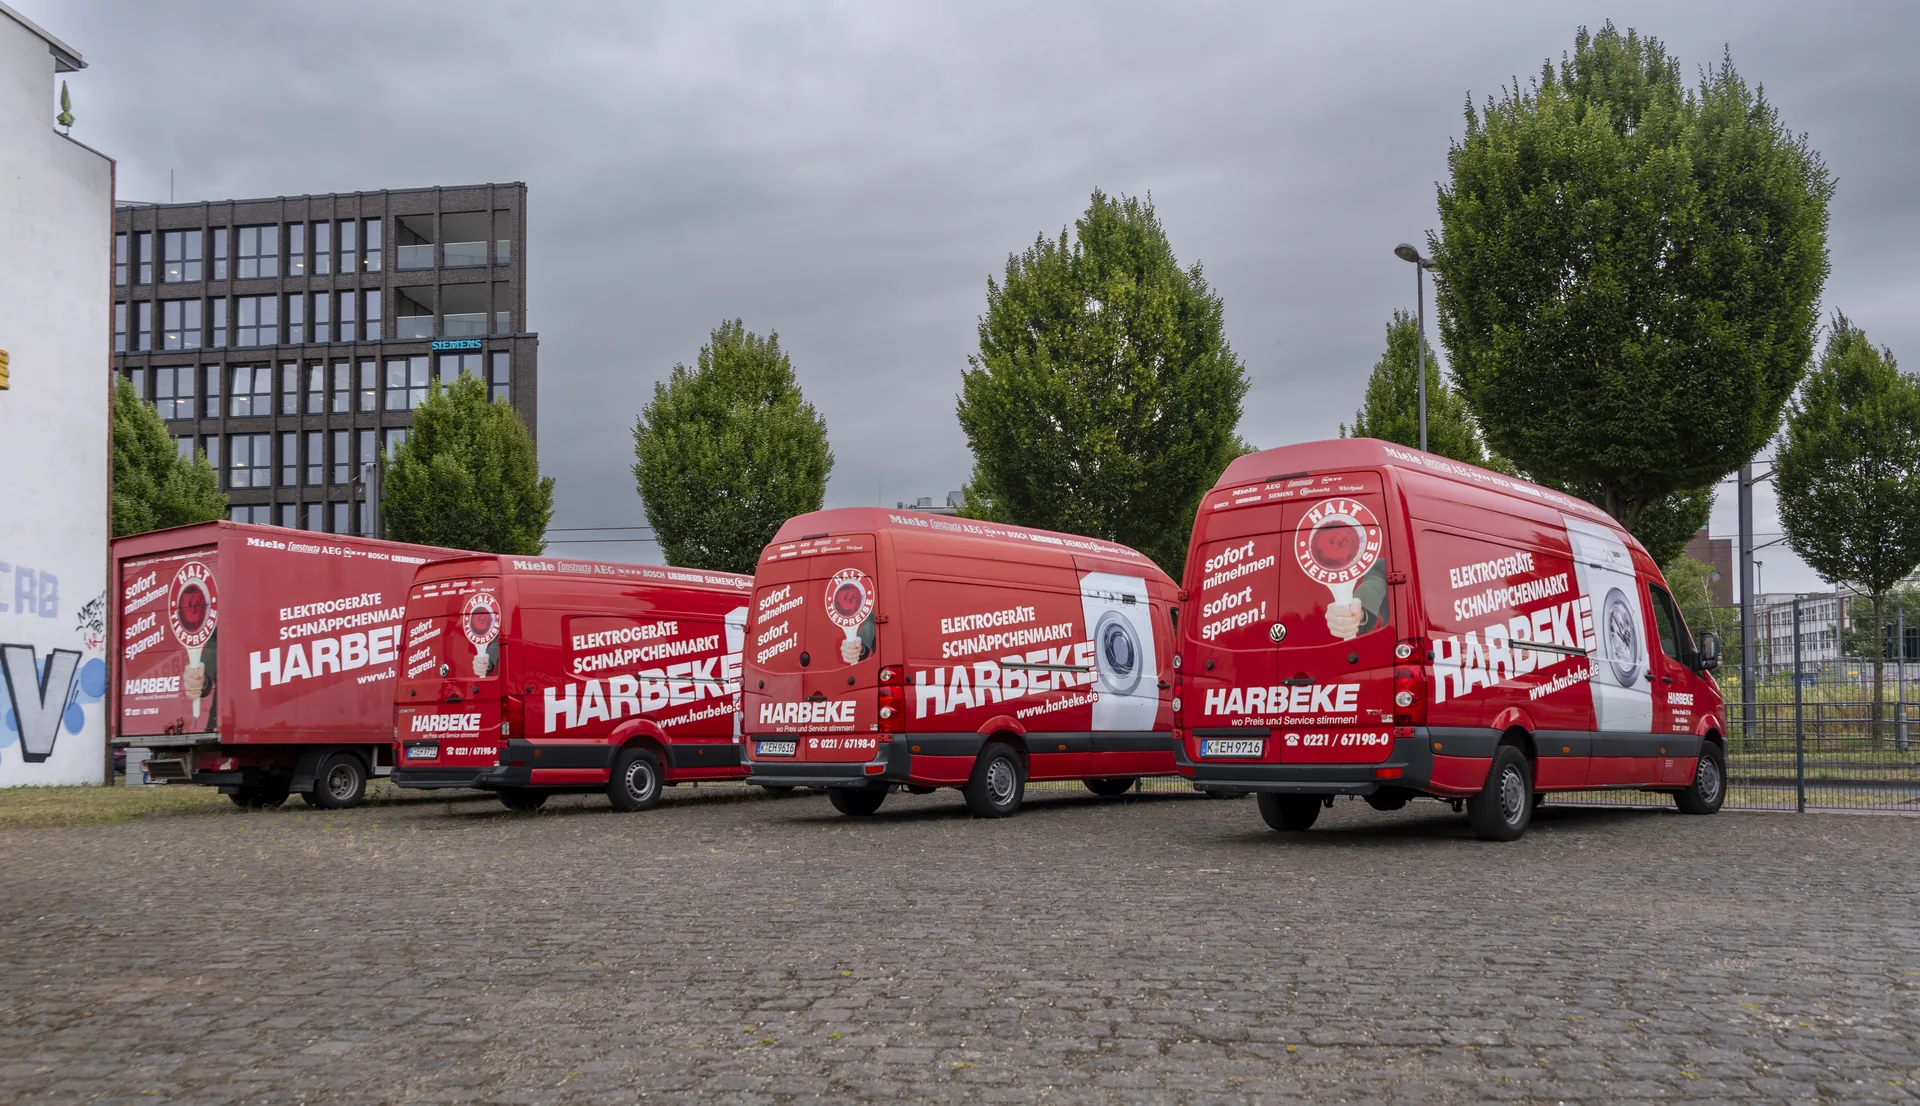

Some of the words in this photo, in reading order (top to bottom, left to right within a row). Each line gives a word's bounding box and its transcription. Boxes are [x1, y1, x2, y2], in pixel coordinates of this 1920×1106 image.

[432, 340, 482, 350] SIEMENS
[1383, 446, 1422, 464] Miele
[1232, 487, 1257, 496] Miele
[1268, 490, 1294, 499] SIEMENS
[888, 514, 928, 527] Miele
[962, 524, 983, 534] AEG
[1308, 500, 1363, 524] HALT
[247, 538, 286, 550] Miele
[321, 546, 341, 555] AEG
[368, 552, 389, 560] BOSCH
[1204, 540, 1255, 573] sofort
[1300, 541, 1379, 582] TIEFPREISE
[178, 565, 211, 584] HALT
[513, 560, 555, 571] Miele
[594, 565, 615, 575] AEG
[643, 569, 665, 578] BOSCH
[704, 576, 735, 586] SIEMENS
[1203, 555, 1275, 591] mitnehmen
[1450, 552, 1535, 589] ELEKTROGERÄTE
[124, 584, 168, 615] mitnehmen
[125, 571, 156, 600] sofort
[759, 585, 791, 610] sofort
[1454, 572, 1569, 621] SCHNÄPPCHENMARKT
[279, 593, 382, 621] ELEKTROGERÄTE
[470, 595, 495, 607] HALT
[758, 596, 803, 624] mitnehmen
[827, 598, 873, 626] TIEFPREISE
[1203, 586, 1253, 618] sofort
[125, 612, 156, 640] sofort
[171, 609, 218, 645] TIEFPREISE
[279, 606, 406, 640] SCHNÄPPCHENMAR
[410, 618, 432, 637] sofort
[465, 622, 500, 643] TIEFPREISE
[757, 620, 789, 646] sofort
[940, 606, 1036, 635] ELEKTROGERÄTE
[1202, 600, 1266, 640] sparen!
[125, 625, 164, 660] sparen!
[572, 621, 678, 651] ELEKTROGERÄTE
[757, 632, 798, 664] sparen!
[942, 622, 1073, 659] SCHNÄPPCHENMARKT
[1432, 594, 1597, 704] HARBEKE
[249, 624, 402, 691] HARBE
[408, 646, 431, 665] sofort
[408, 656, 436, 679] sparen!
[573, 634, 719, 674] SCHNÄPPCHENMARKT
[125, 676, 180, 694] HARBEKE
[544, 652, 743, 733] HARBEKE
[915, 640, 1099, 719] HARBEKE
[1529, 659, 1599, 700] www.harbeke.de
[657, 697, 741, 729] www.harbeke.d
[759, 700, 857, 724] HARBEKE
[1016, 690, 1099, 720] www.harbeke.de
[1204, 683, 1361, 716] HARBEKE
[411, 713, 482, 732] HARBEKE
[808, 724, 828, 732] Service
[1244, 717, 1264, 725] Preis
[1266, 716, 1282, 725] und
[1284, 716, 1314, 725] Service
[1316, 715, 1358, 724] stimmen!
[455, 747, 468, 755] 0221
[472, 747, 497, 755] 67198-0
[820, 739, 837, 748] 0221
[844, 738, 876, 748] 67198-0
[1303, 734, 1329, 746] 0221
[1340, 733, 1389, 746] 67198-0
